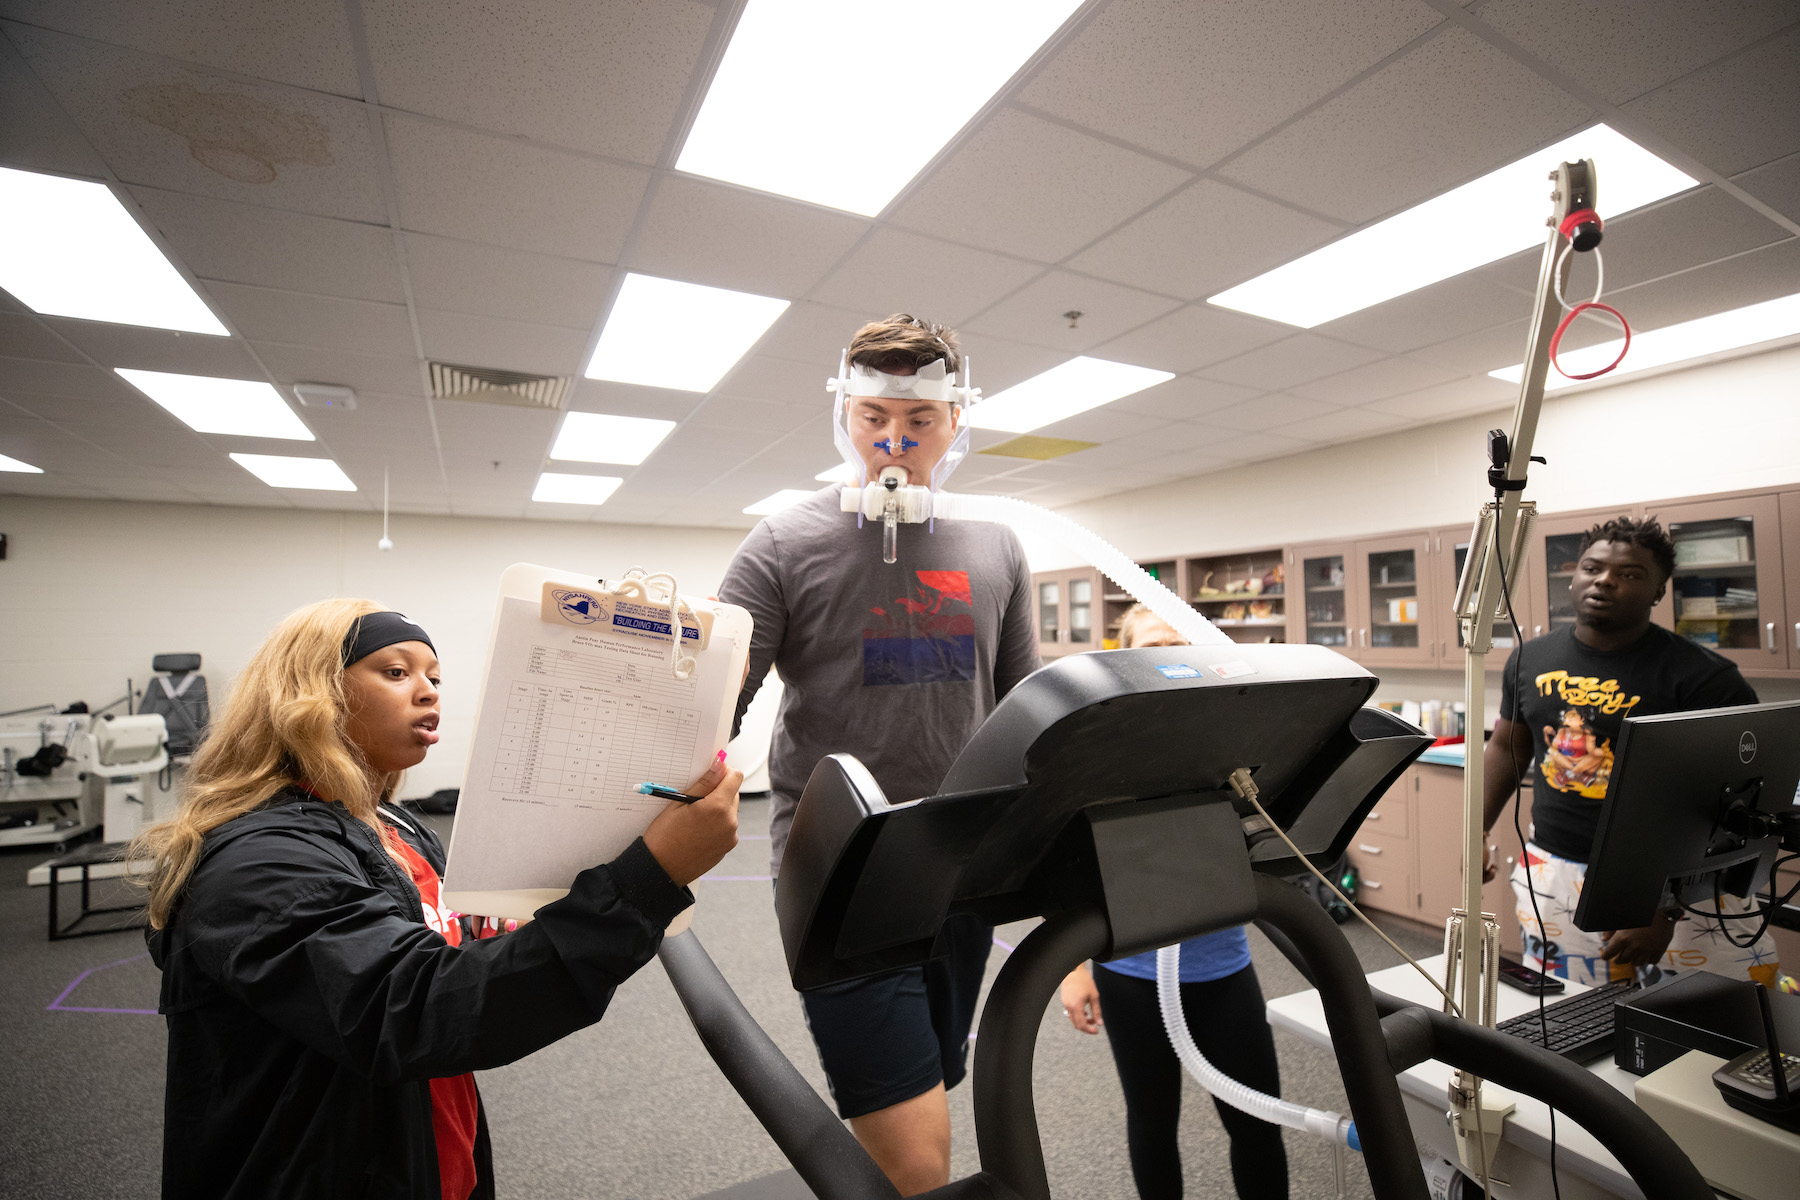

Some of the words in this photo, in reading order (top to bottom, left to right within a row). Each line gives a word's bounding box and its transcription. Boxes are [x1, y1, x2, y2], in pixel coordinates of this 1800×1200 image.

[615, 608, 646, 616] RECREATION
[615, 616, 652, 630] "BUILDING
[653, 623, 668, 632] THE
[615, 642, 640, 650] Performance
[1742, 742, 1755, 752] DELL
